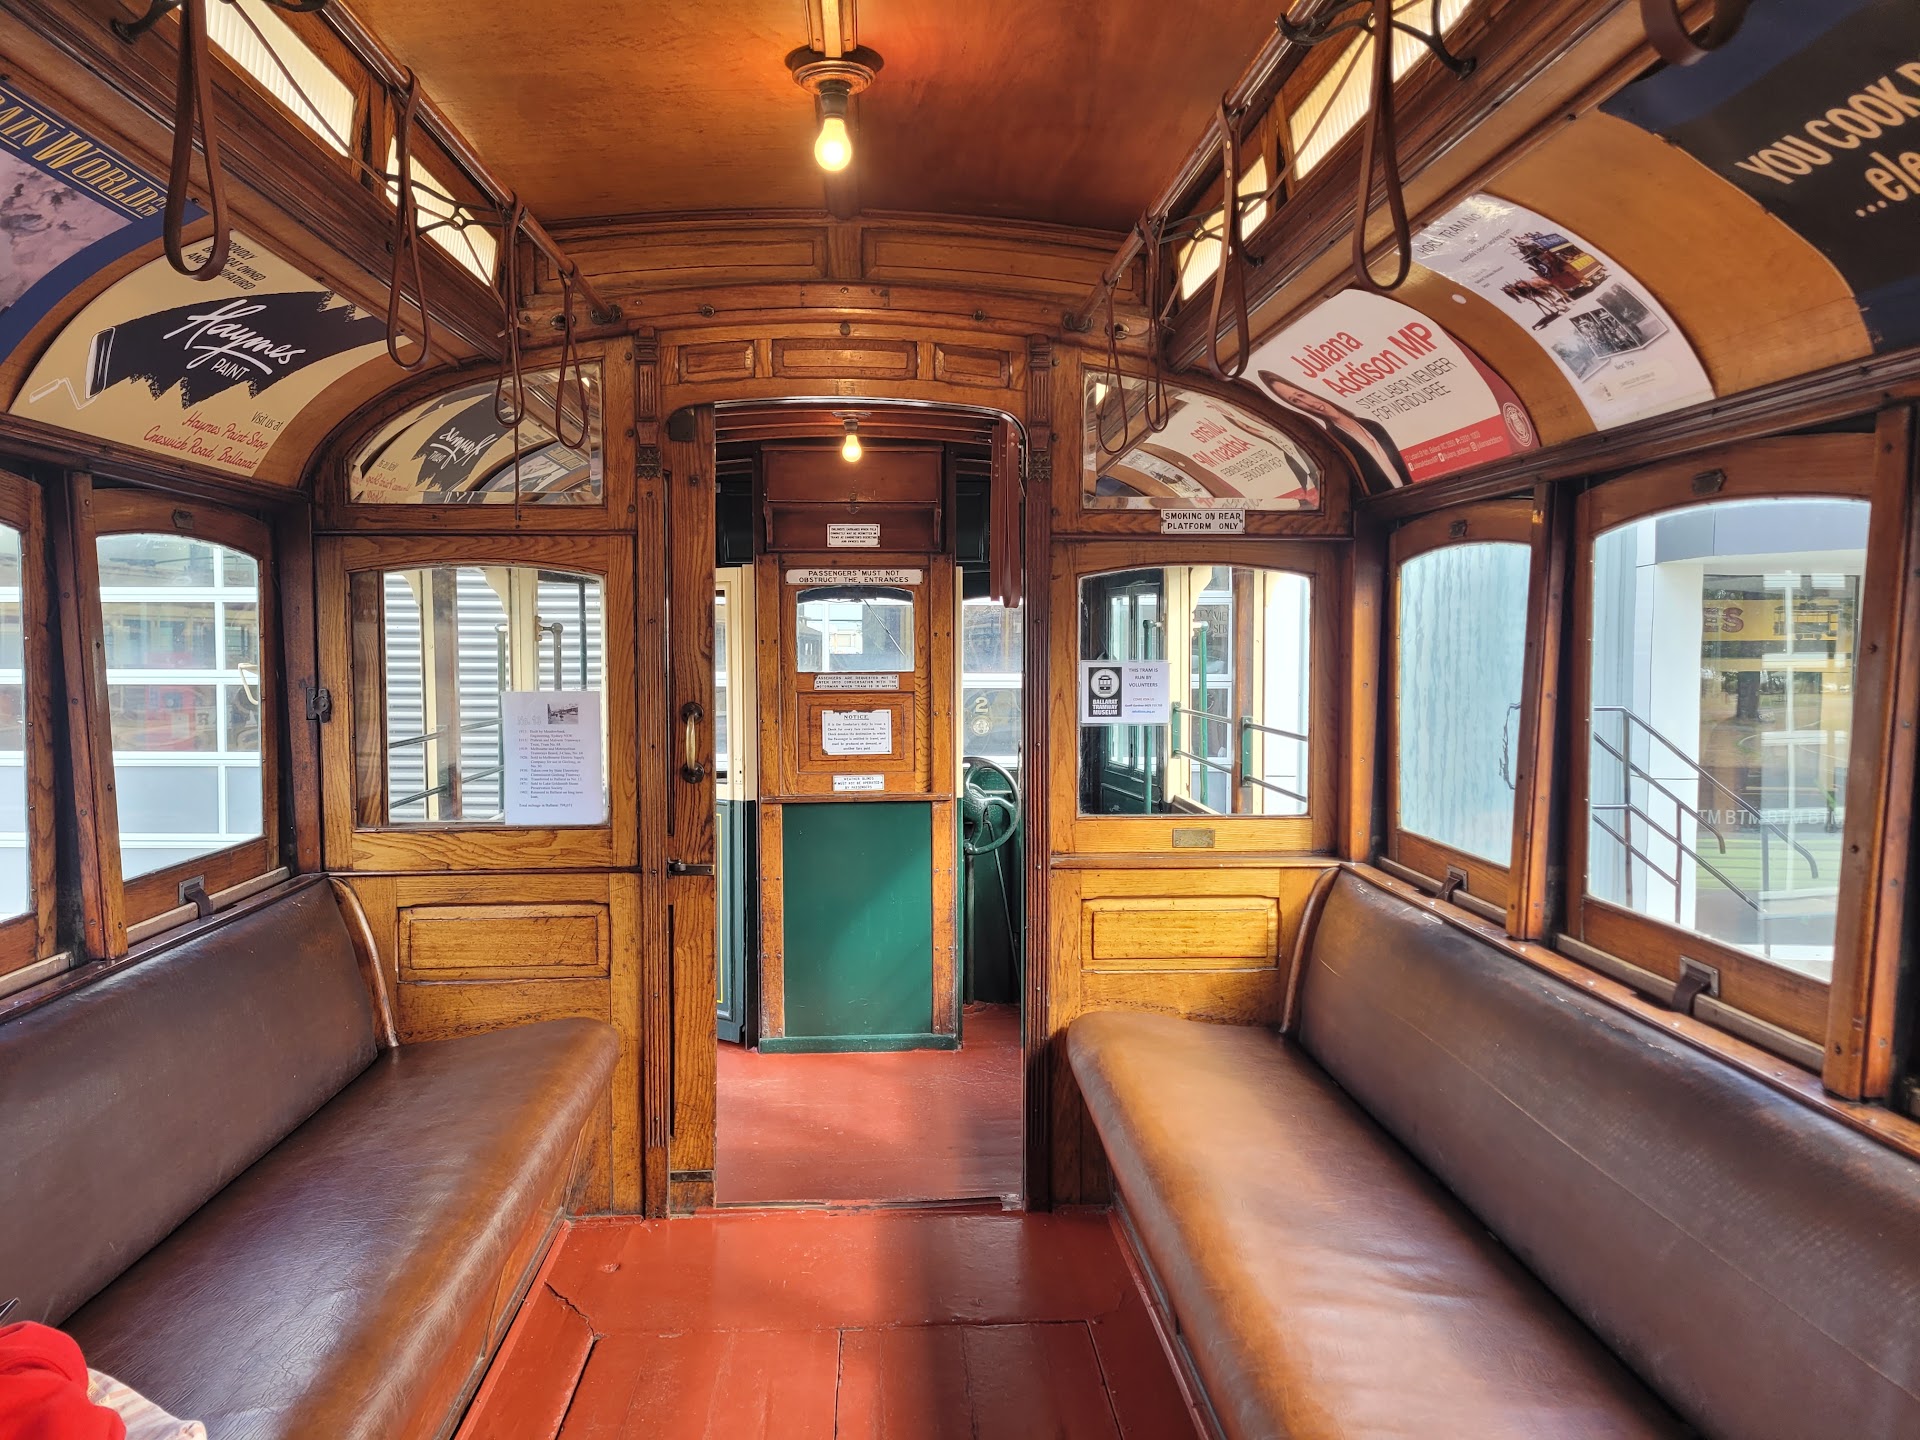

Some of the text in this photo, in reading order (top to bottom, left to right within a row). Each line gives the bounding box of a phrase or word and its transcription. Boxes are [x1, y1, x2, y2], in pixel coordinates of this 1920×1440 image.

[0, 95, 158, 208] AIN WORLD
[1734, 75, 1920, 185] YOU COOK
[228, 239, 258, 261] ROUDLY
[1439, 221, 1467, 241] TRAM
[163, 299, 307, 370] Haymes
[1291, 331, 1364, 379] Juliana
[210, 358, 251, 381] PAINT
[1322, 322, 1438, 398] Addison MP
[1355, 357, 1458, 410] STATE LABOR MEMBER
[1371, 380, 1452, 423] FOR WENDOUREE
[181, 410, 269, 453] Haymes Paint Shop
[251, 411, 284, 431] Visit us at
[143, 425, 260, 470] Creswick Road, Ballarat
[1165, 512, 1241, 520] SMOKING ON REAR
[1725, 809, 1761, 825] BTM
